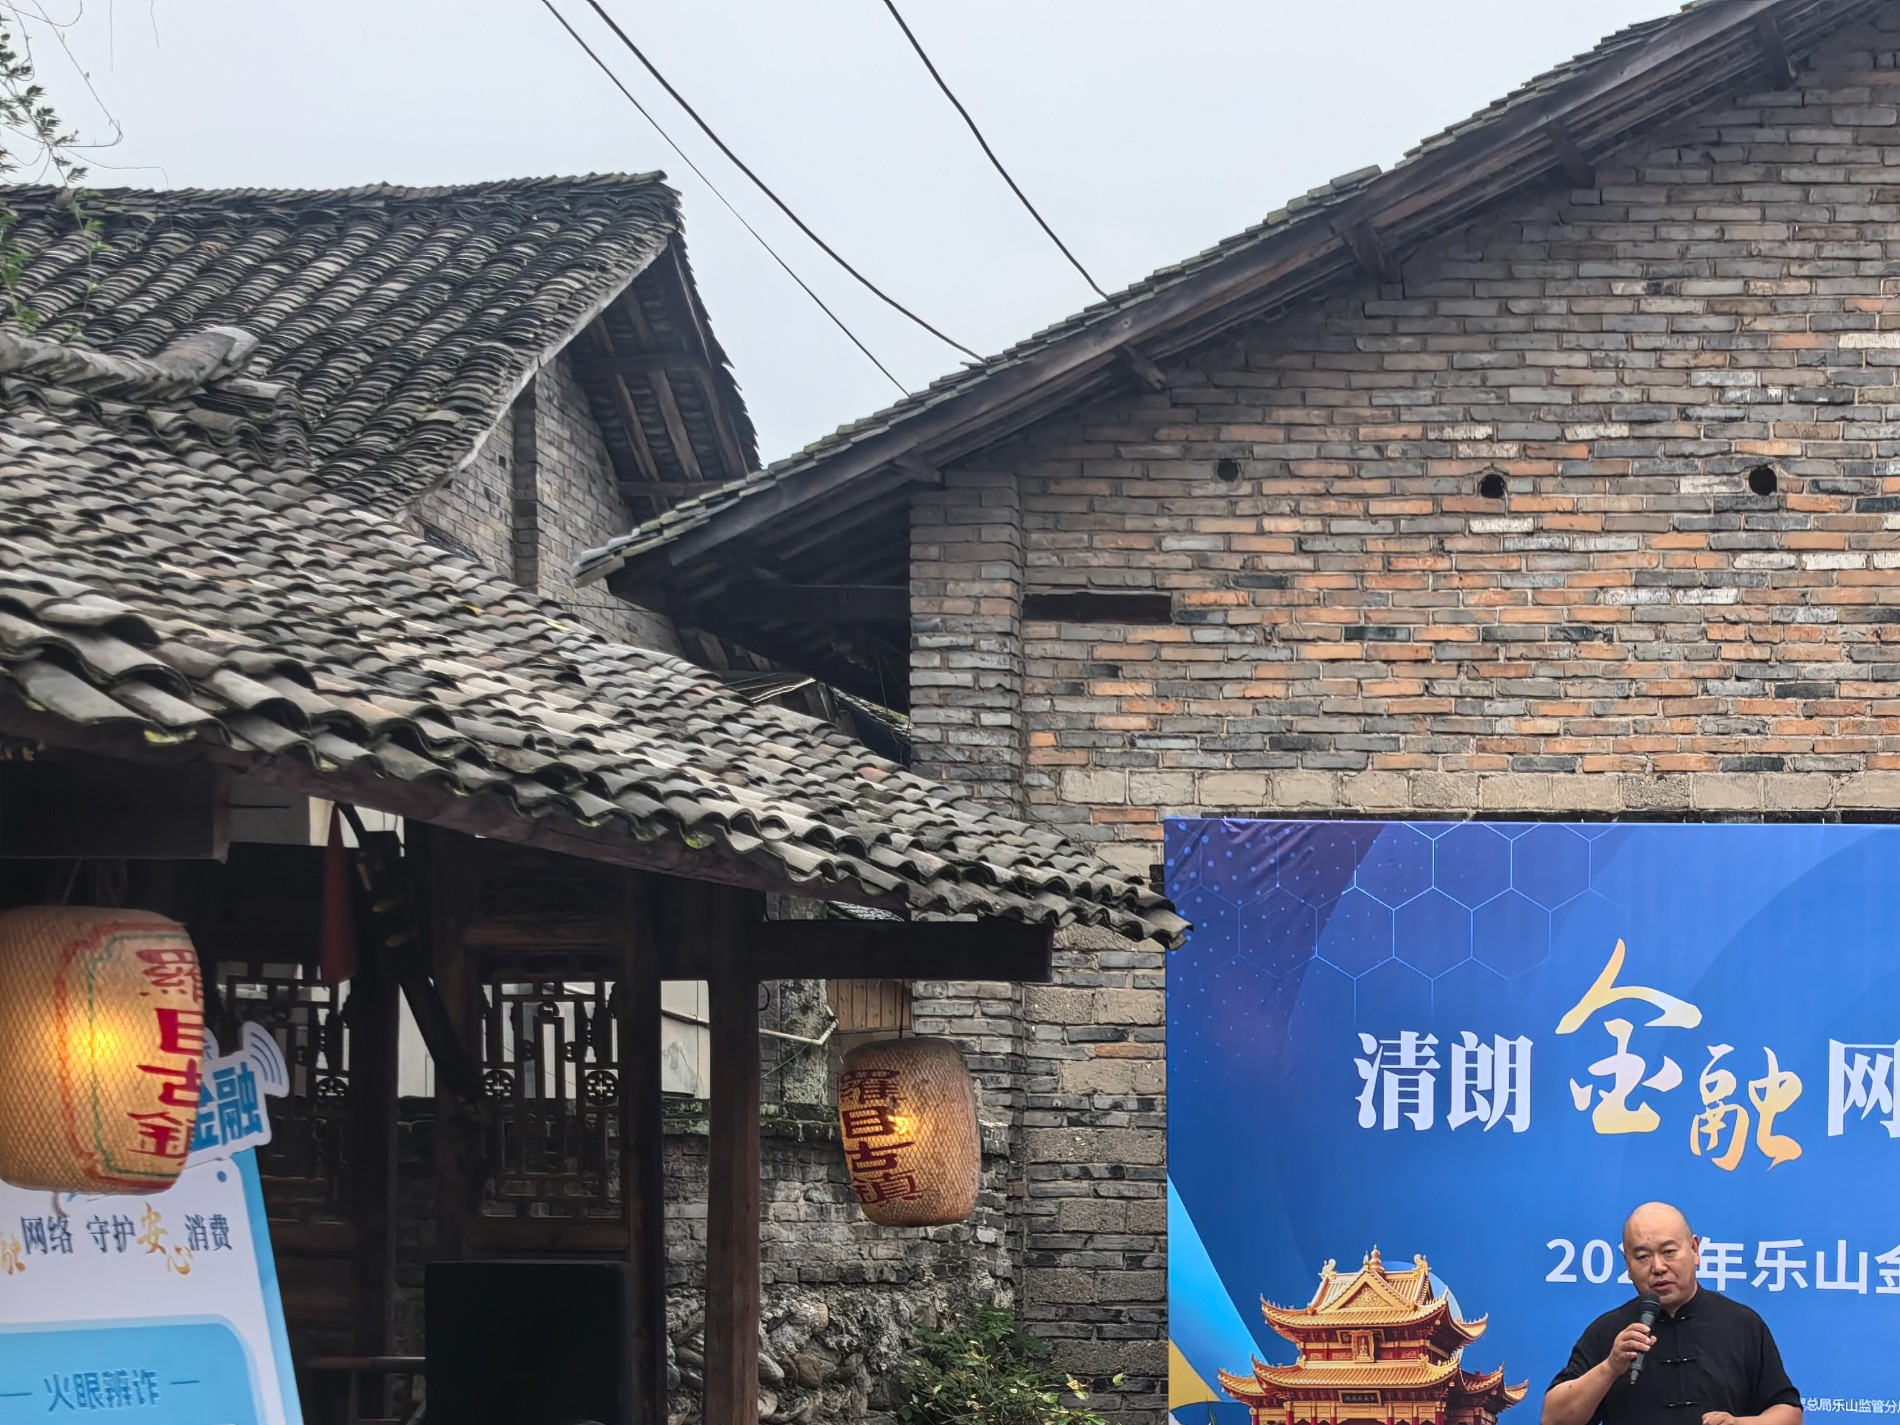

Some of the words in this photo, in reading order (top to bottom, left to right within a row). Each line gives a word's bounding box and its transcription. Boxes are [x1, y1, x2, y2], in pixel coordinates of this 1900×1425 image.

[86, 1200, 233, 1276] 守护安心消费
[44, 1368, 160, 1413] 火眼辨诈
